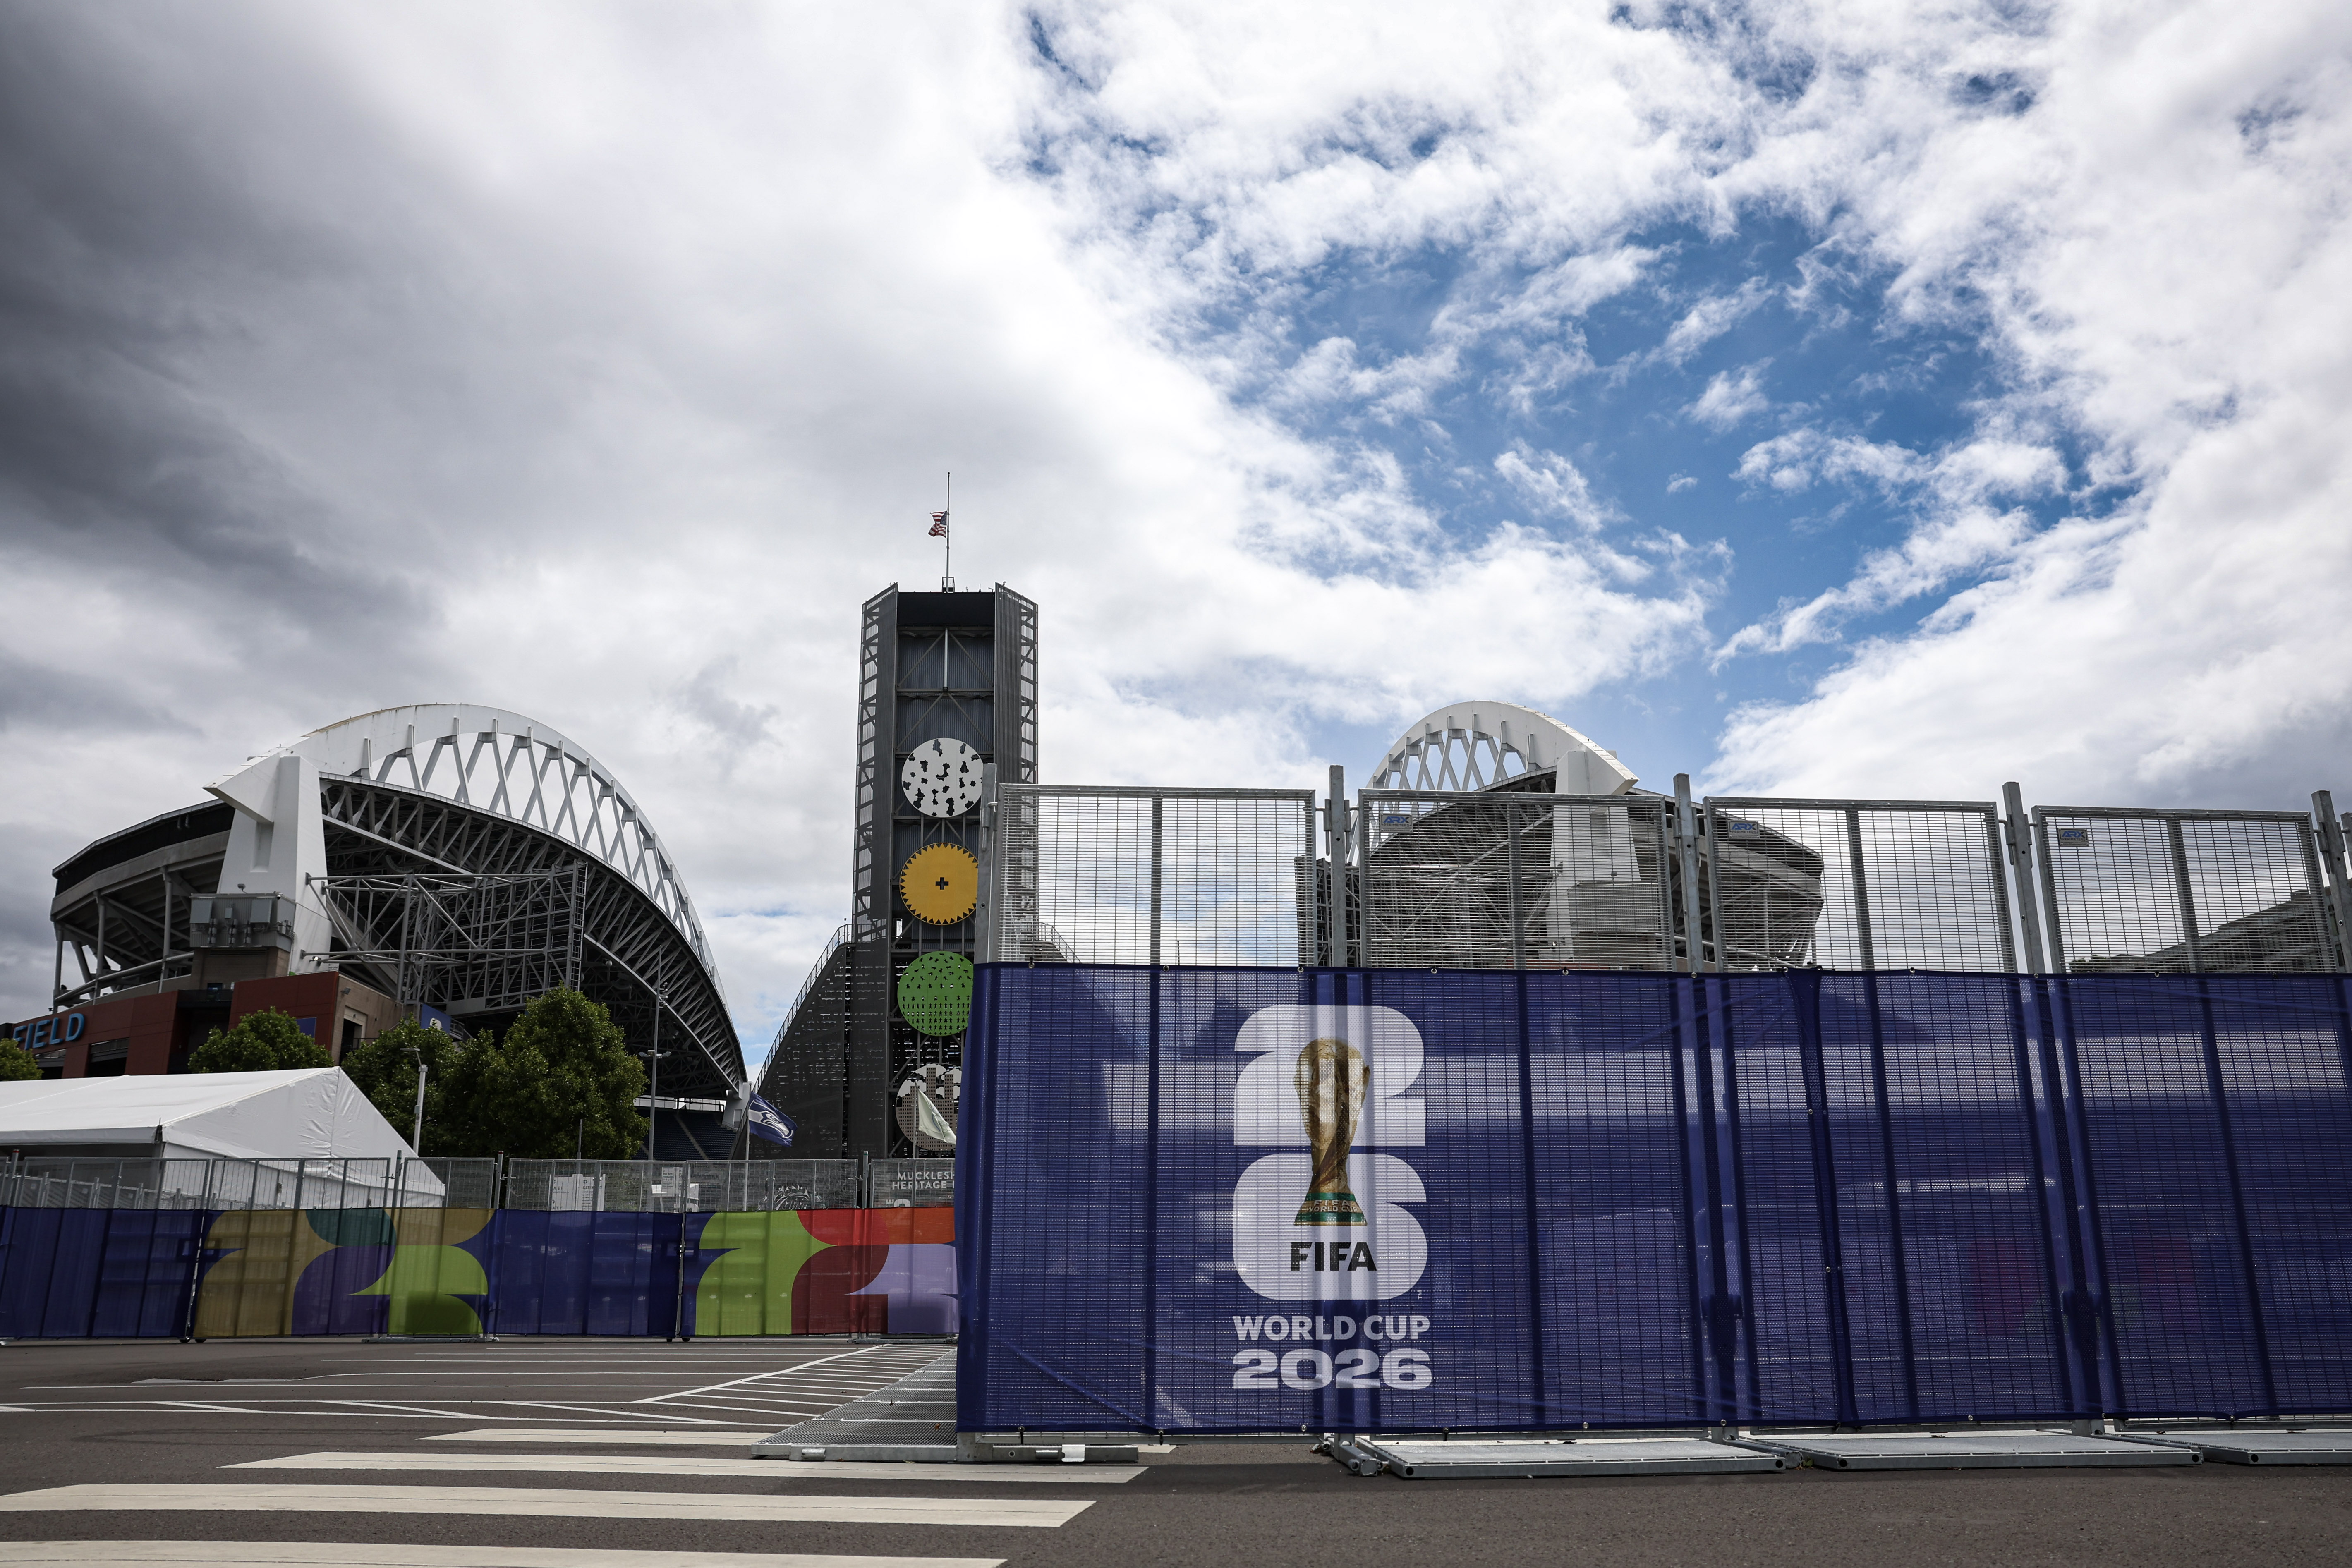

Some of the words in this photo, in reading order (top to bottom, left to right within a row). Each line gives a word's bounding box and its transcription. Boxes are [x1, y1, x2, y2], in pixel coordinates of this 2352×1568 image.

[12, 1013, 85, 1051] FIELD
[892, 1180, 947, 1190] HERITAGE
[1291, 1242, 1377, 1271] FIFA
[1233, 1315, 1356, 1341] WORLD
[1363, 1315, 1430, 1340] CUP
[1232, 1348, 1432, 1390] 2026
